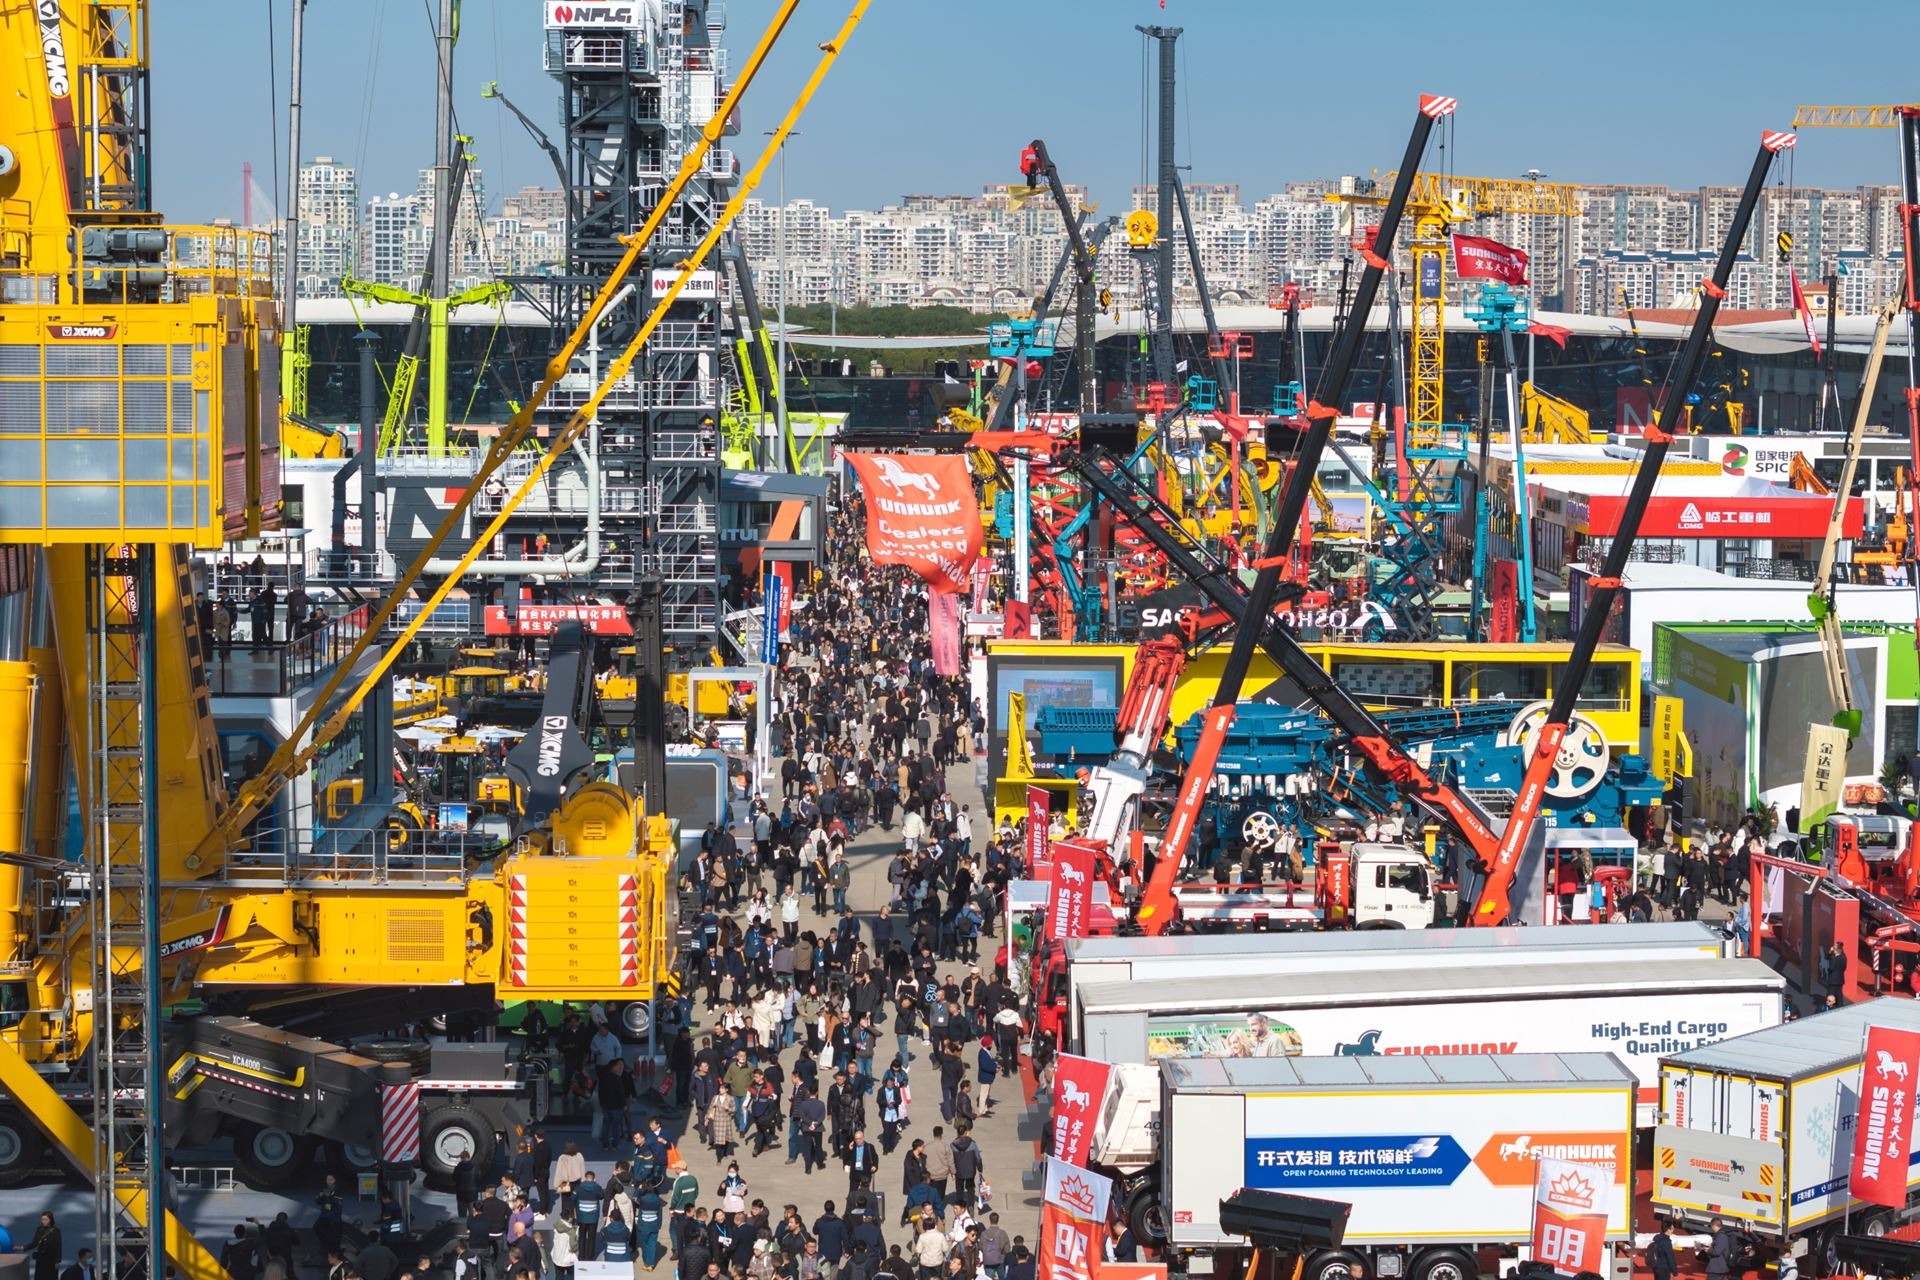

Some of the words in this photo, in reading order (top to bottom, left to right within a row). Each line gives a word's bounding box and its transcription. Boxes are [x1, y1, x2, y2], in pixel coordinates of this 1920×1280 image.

[40, 21, 69, 97] XCMG
[73, 327, 106, 337] XCMG
[1755, 462, 1789, 473] SPIC
[879, 519, 965, 539] Dealers
[537, 728, 564, 777] XCMG
[665, 743, 702, 757] CMG
[1815, 742, 1834, 792] 金达重工
[568, 879, 578, 887] 10t
[568, 895, 578, 903] 10t
[568, 911, 578, 919] 10t
[1054, 887, 1071, 939] SUNHU
[568, 927, 578, 935] 10t
[169, 935, 205, 952] XCMG
[568, 943, 578, 951] 10t
[1591, 1022, 1673, 1041] High-End
[1677, 1020, 1728, 1039] Cargo
[1626, 1038, 1691, 1056] Quality
[232, 1054, 261, 1071] XCA4000
[1861, 1086, 1889, 1181] SUNHUNK
[1257, 1150, 1333, 1167] 开式发泡
[1338, 1149, 1414, 1166] 技术领鲜
[1689, 1158, 1730, 1173] SUNHUNK
[1283, 1169, 1306, 1177] OPEN
[1308, 1168, 1347, 1177] FOAMING
[1348, 1168, 1404, 1176] TECHNOLOGY
[1406, 1167, 1443, 1175] LEADING
